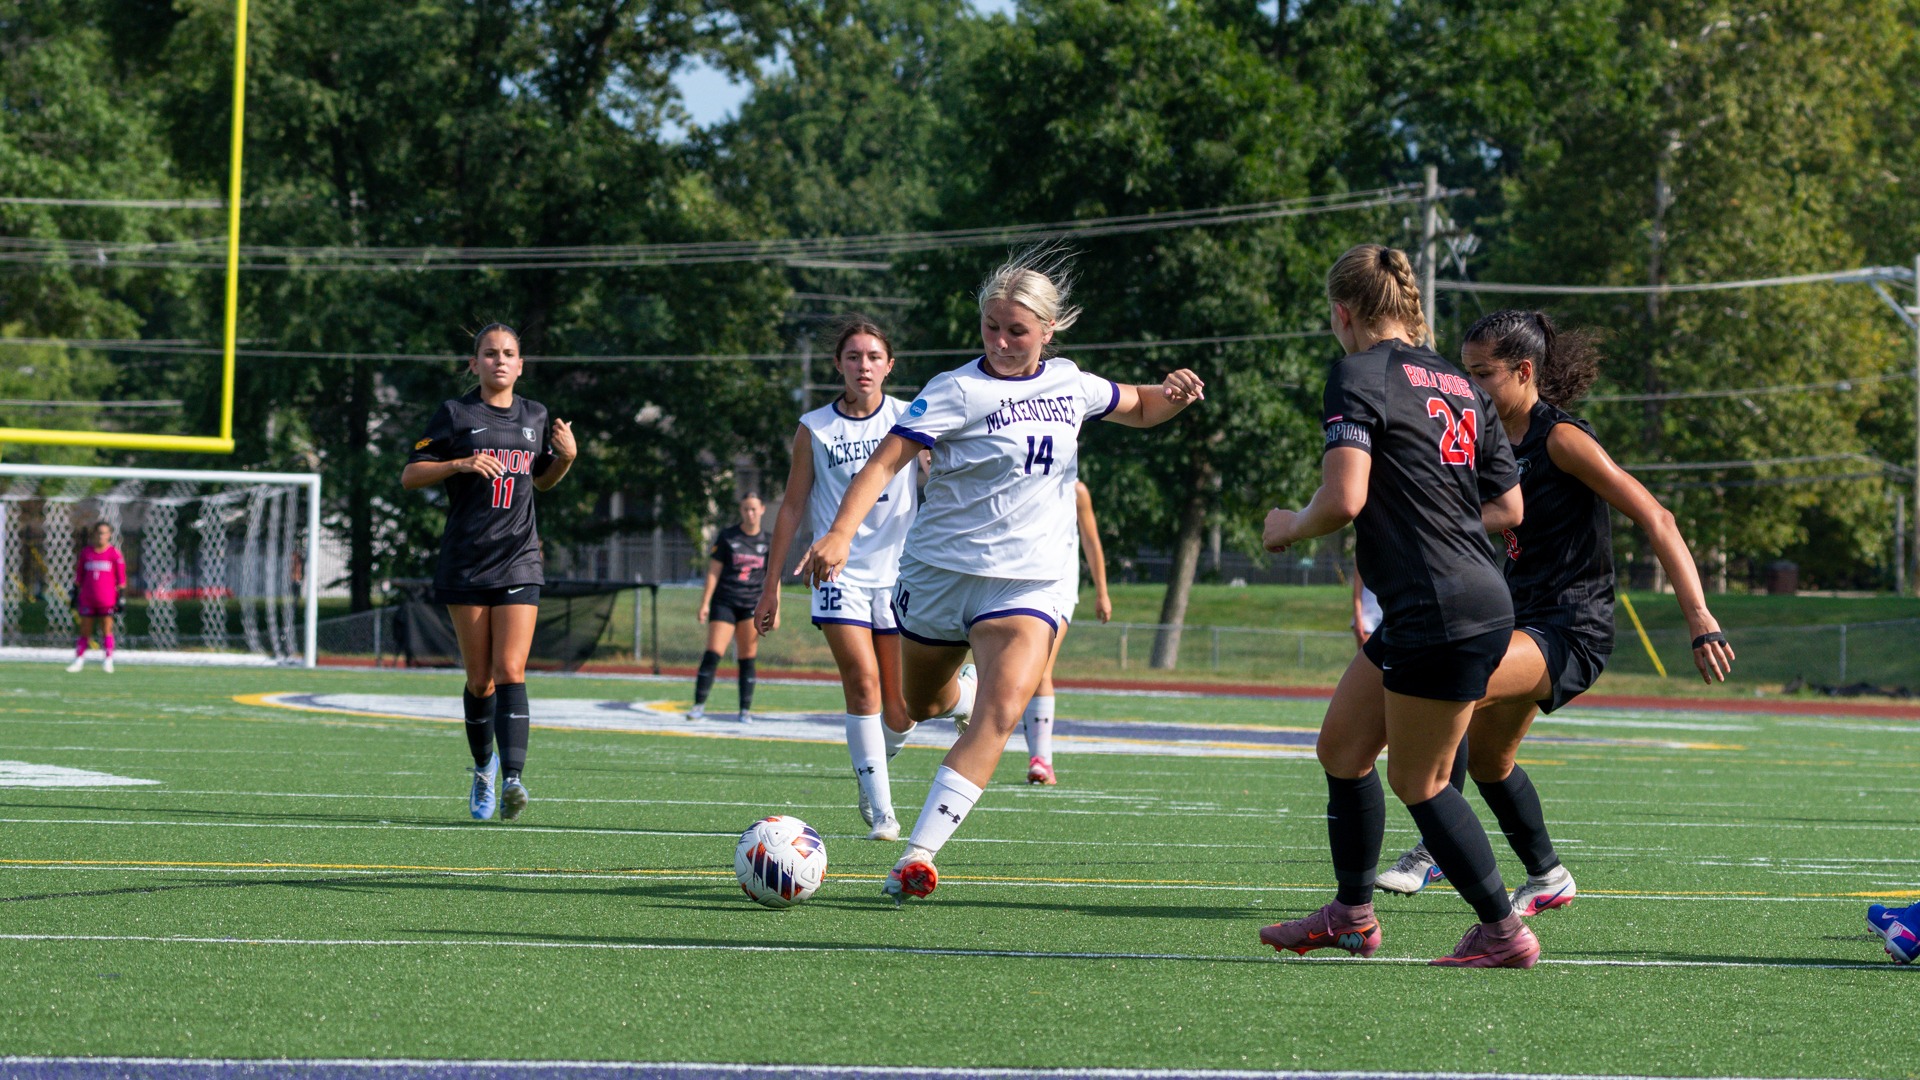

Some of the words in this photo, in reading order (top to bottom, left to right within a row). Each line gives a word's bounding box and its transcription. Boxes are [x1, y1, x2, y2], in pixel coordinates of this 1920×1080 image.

[985, 395, 1077, 435] MCKENDREE
[1427, 397, 1477, 470] 24
[1024, 435, 1054, 476] 14
[492, 476, 515, 509] 11
[820, 586, 842, 611] 32
[896, 581, 911, 618] 14
